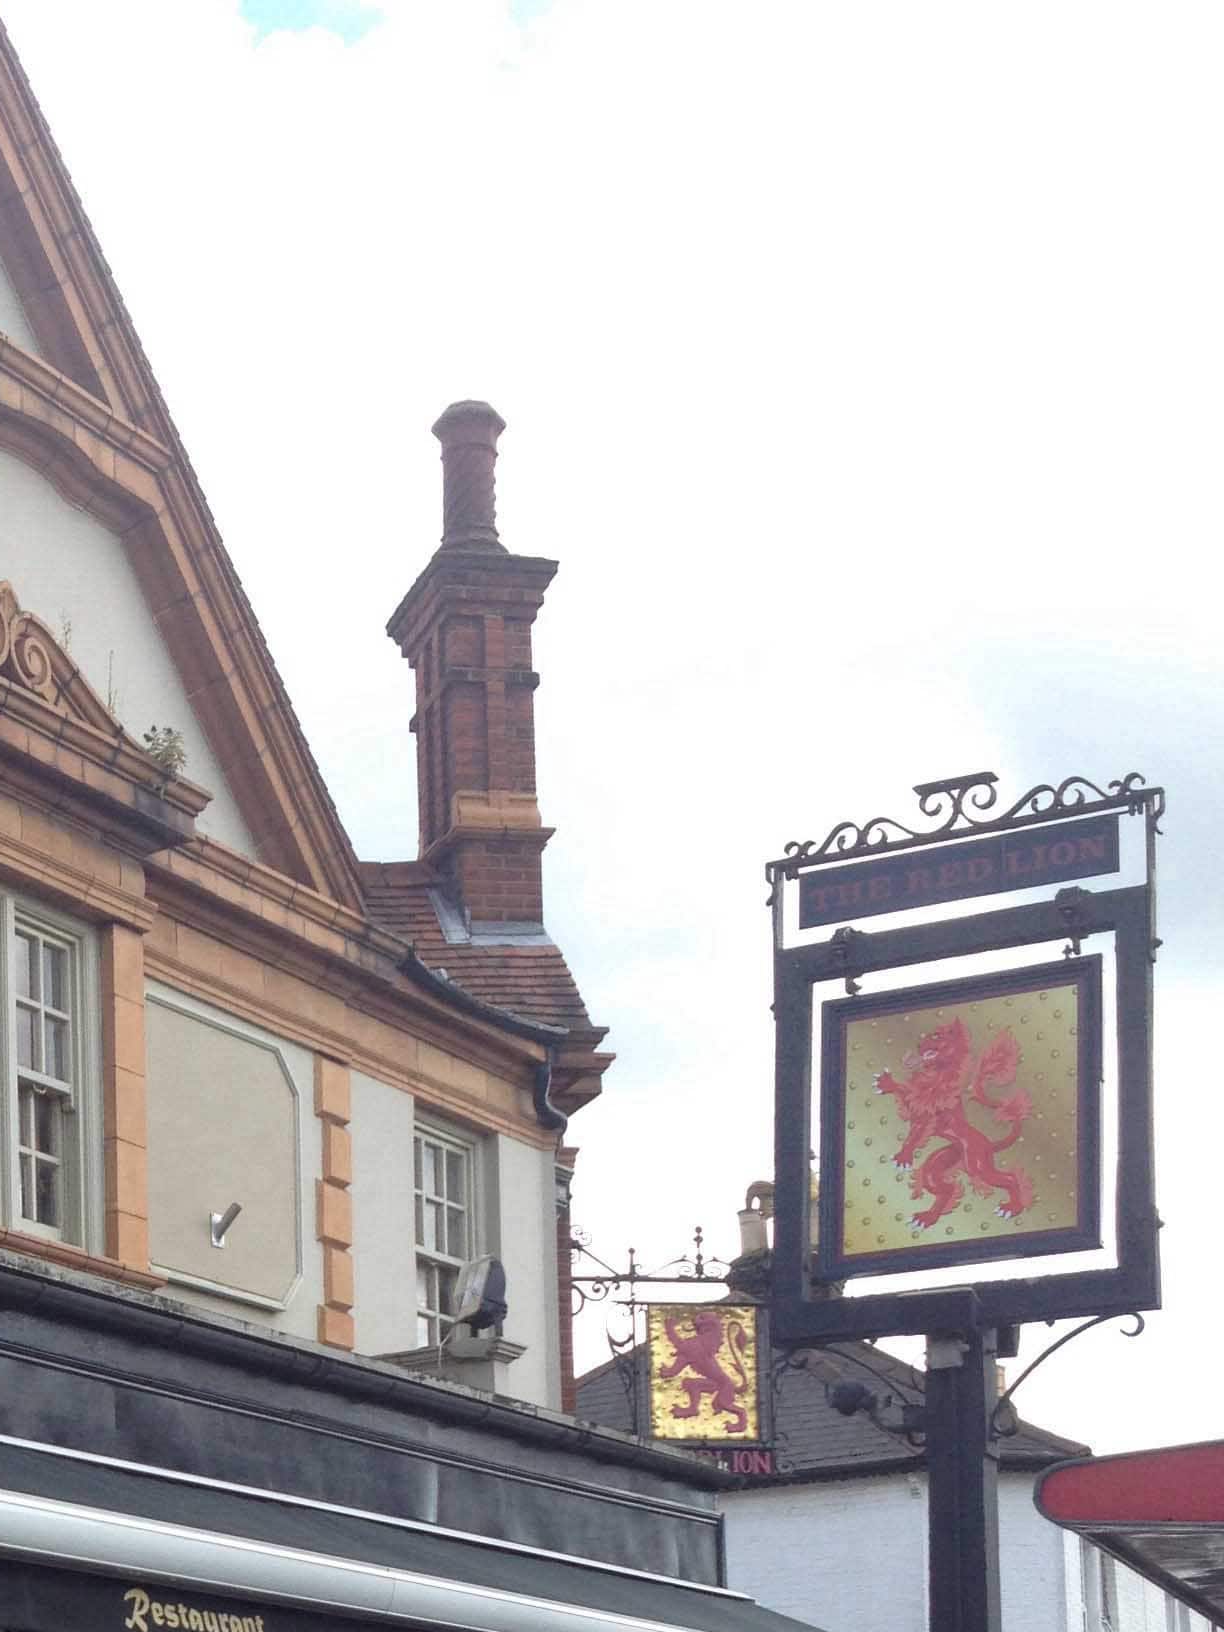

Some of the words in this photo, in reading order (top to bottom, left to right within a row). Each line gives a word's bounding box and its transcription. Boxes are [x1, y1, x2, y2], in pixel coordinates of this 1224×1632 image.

[808, 875, 892, 912] THE
[906, 857, 993, 890] RED
[1005, 836, 1106, 873] LION
